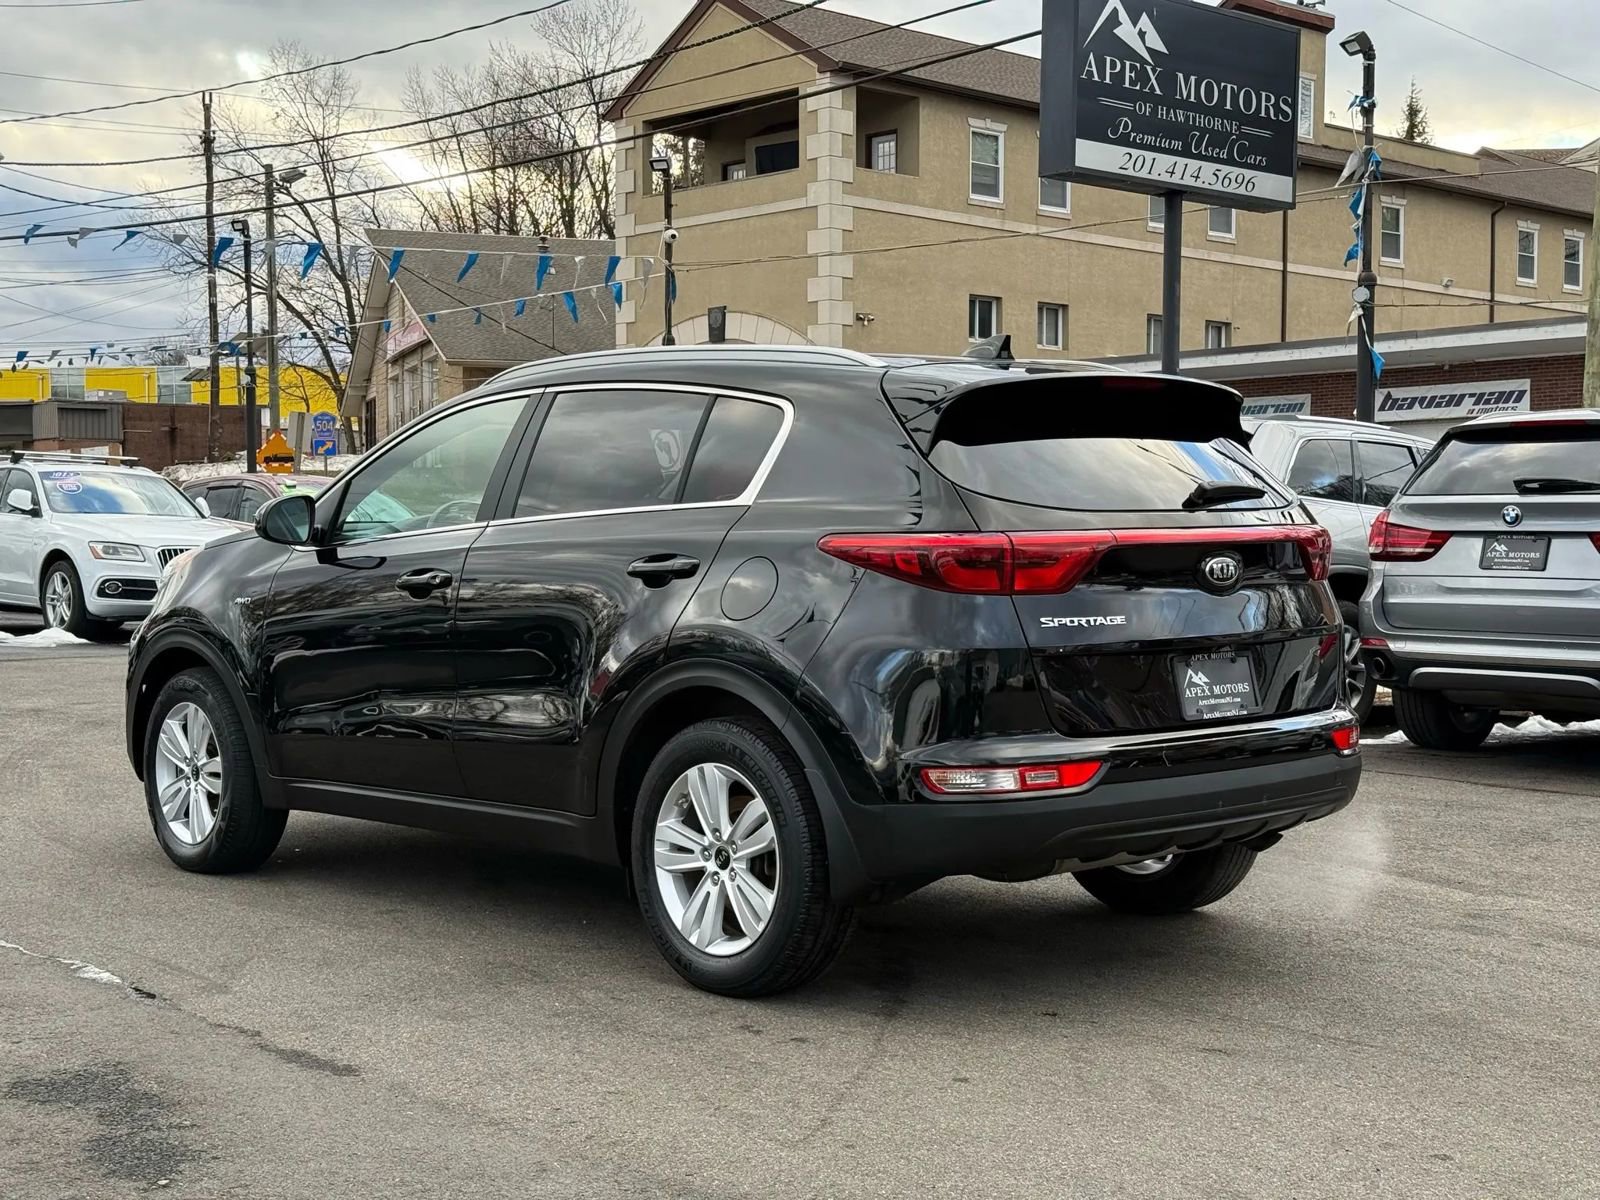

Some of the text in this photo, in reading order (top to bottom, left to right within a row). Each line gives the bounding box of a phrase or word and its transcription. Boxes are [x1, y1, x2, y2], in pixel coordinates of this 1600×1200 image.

[1080, 52, 1293, 123] APEX MOTORS
[1136, 101, 1240, 135] OF HAWTHORNE
[1107, 117, 1267, 167] Premium Used Cars
[1118, 152, 1257, 193] 201.414.5696
[1241, 402, 1305, 415] varian
[1378, 389, 1528, 412] bavarian
[316, 420, 333, 431] 504
[1211, 562, 1236, 579] KIA
[234, 597, 251, 605] AWD
[1040, 615, 1127, 628] SPORTAGE
[1191, 652, 1236, 661] APEX MOTORS
[1185, 683, 1250, 698] APEX MOTORS
[715, 850, 729, 867] KIA
